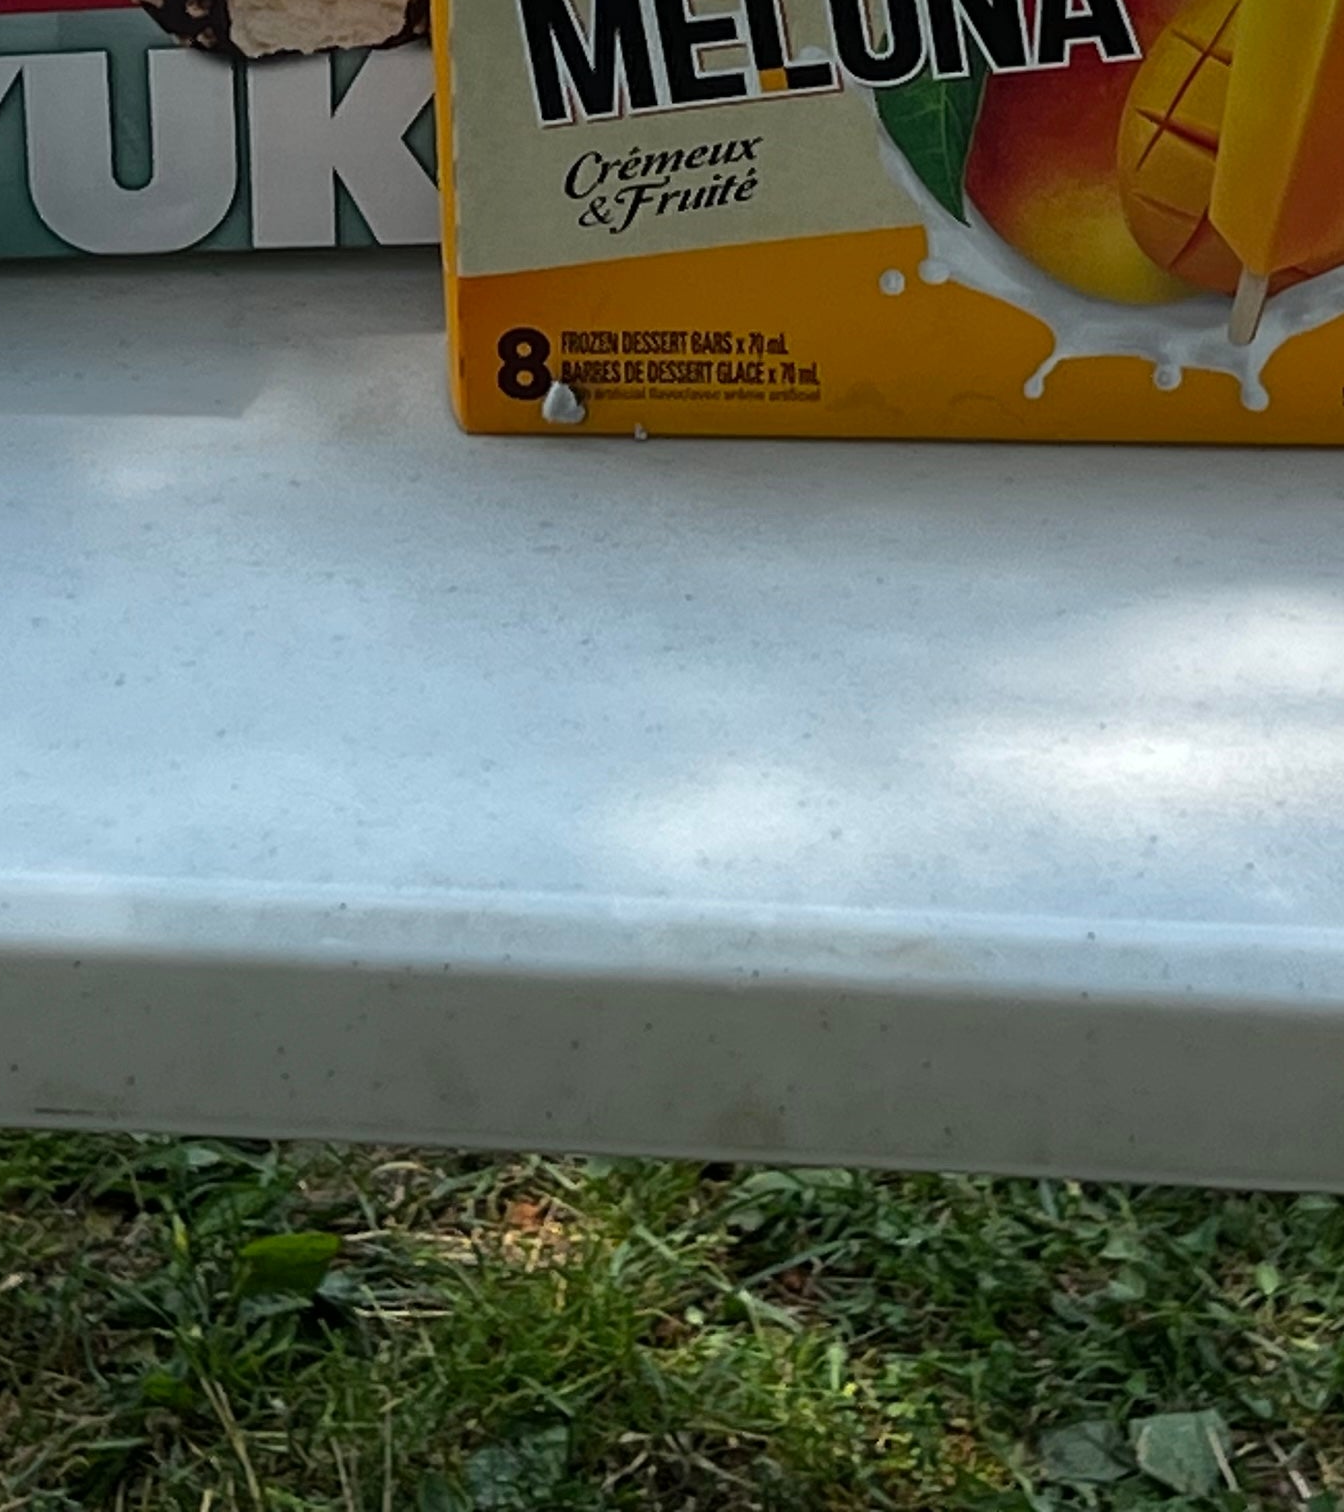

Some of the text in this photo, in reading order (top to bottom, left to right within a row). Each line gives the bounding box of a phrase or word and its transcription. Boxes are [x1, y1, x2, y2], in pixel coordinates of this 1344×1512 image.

[563, 136, 765, 200] Crémeux
[497, 326, 552, 400] 8
[561, 331, 619, 355] FROZEN
[622, 331, 687, 355] DESSERT
[690, 331, 733, 355] BARS
[735, 337, 745, 355] x
[623, 360, 645, 384] DE
[646, 360, 713, 385] DESSERT
[767, 367, 777, 384] x
